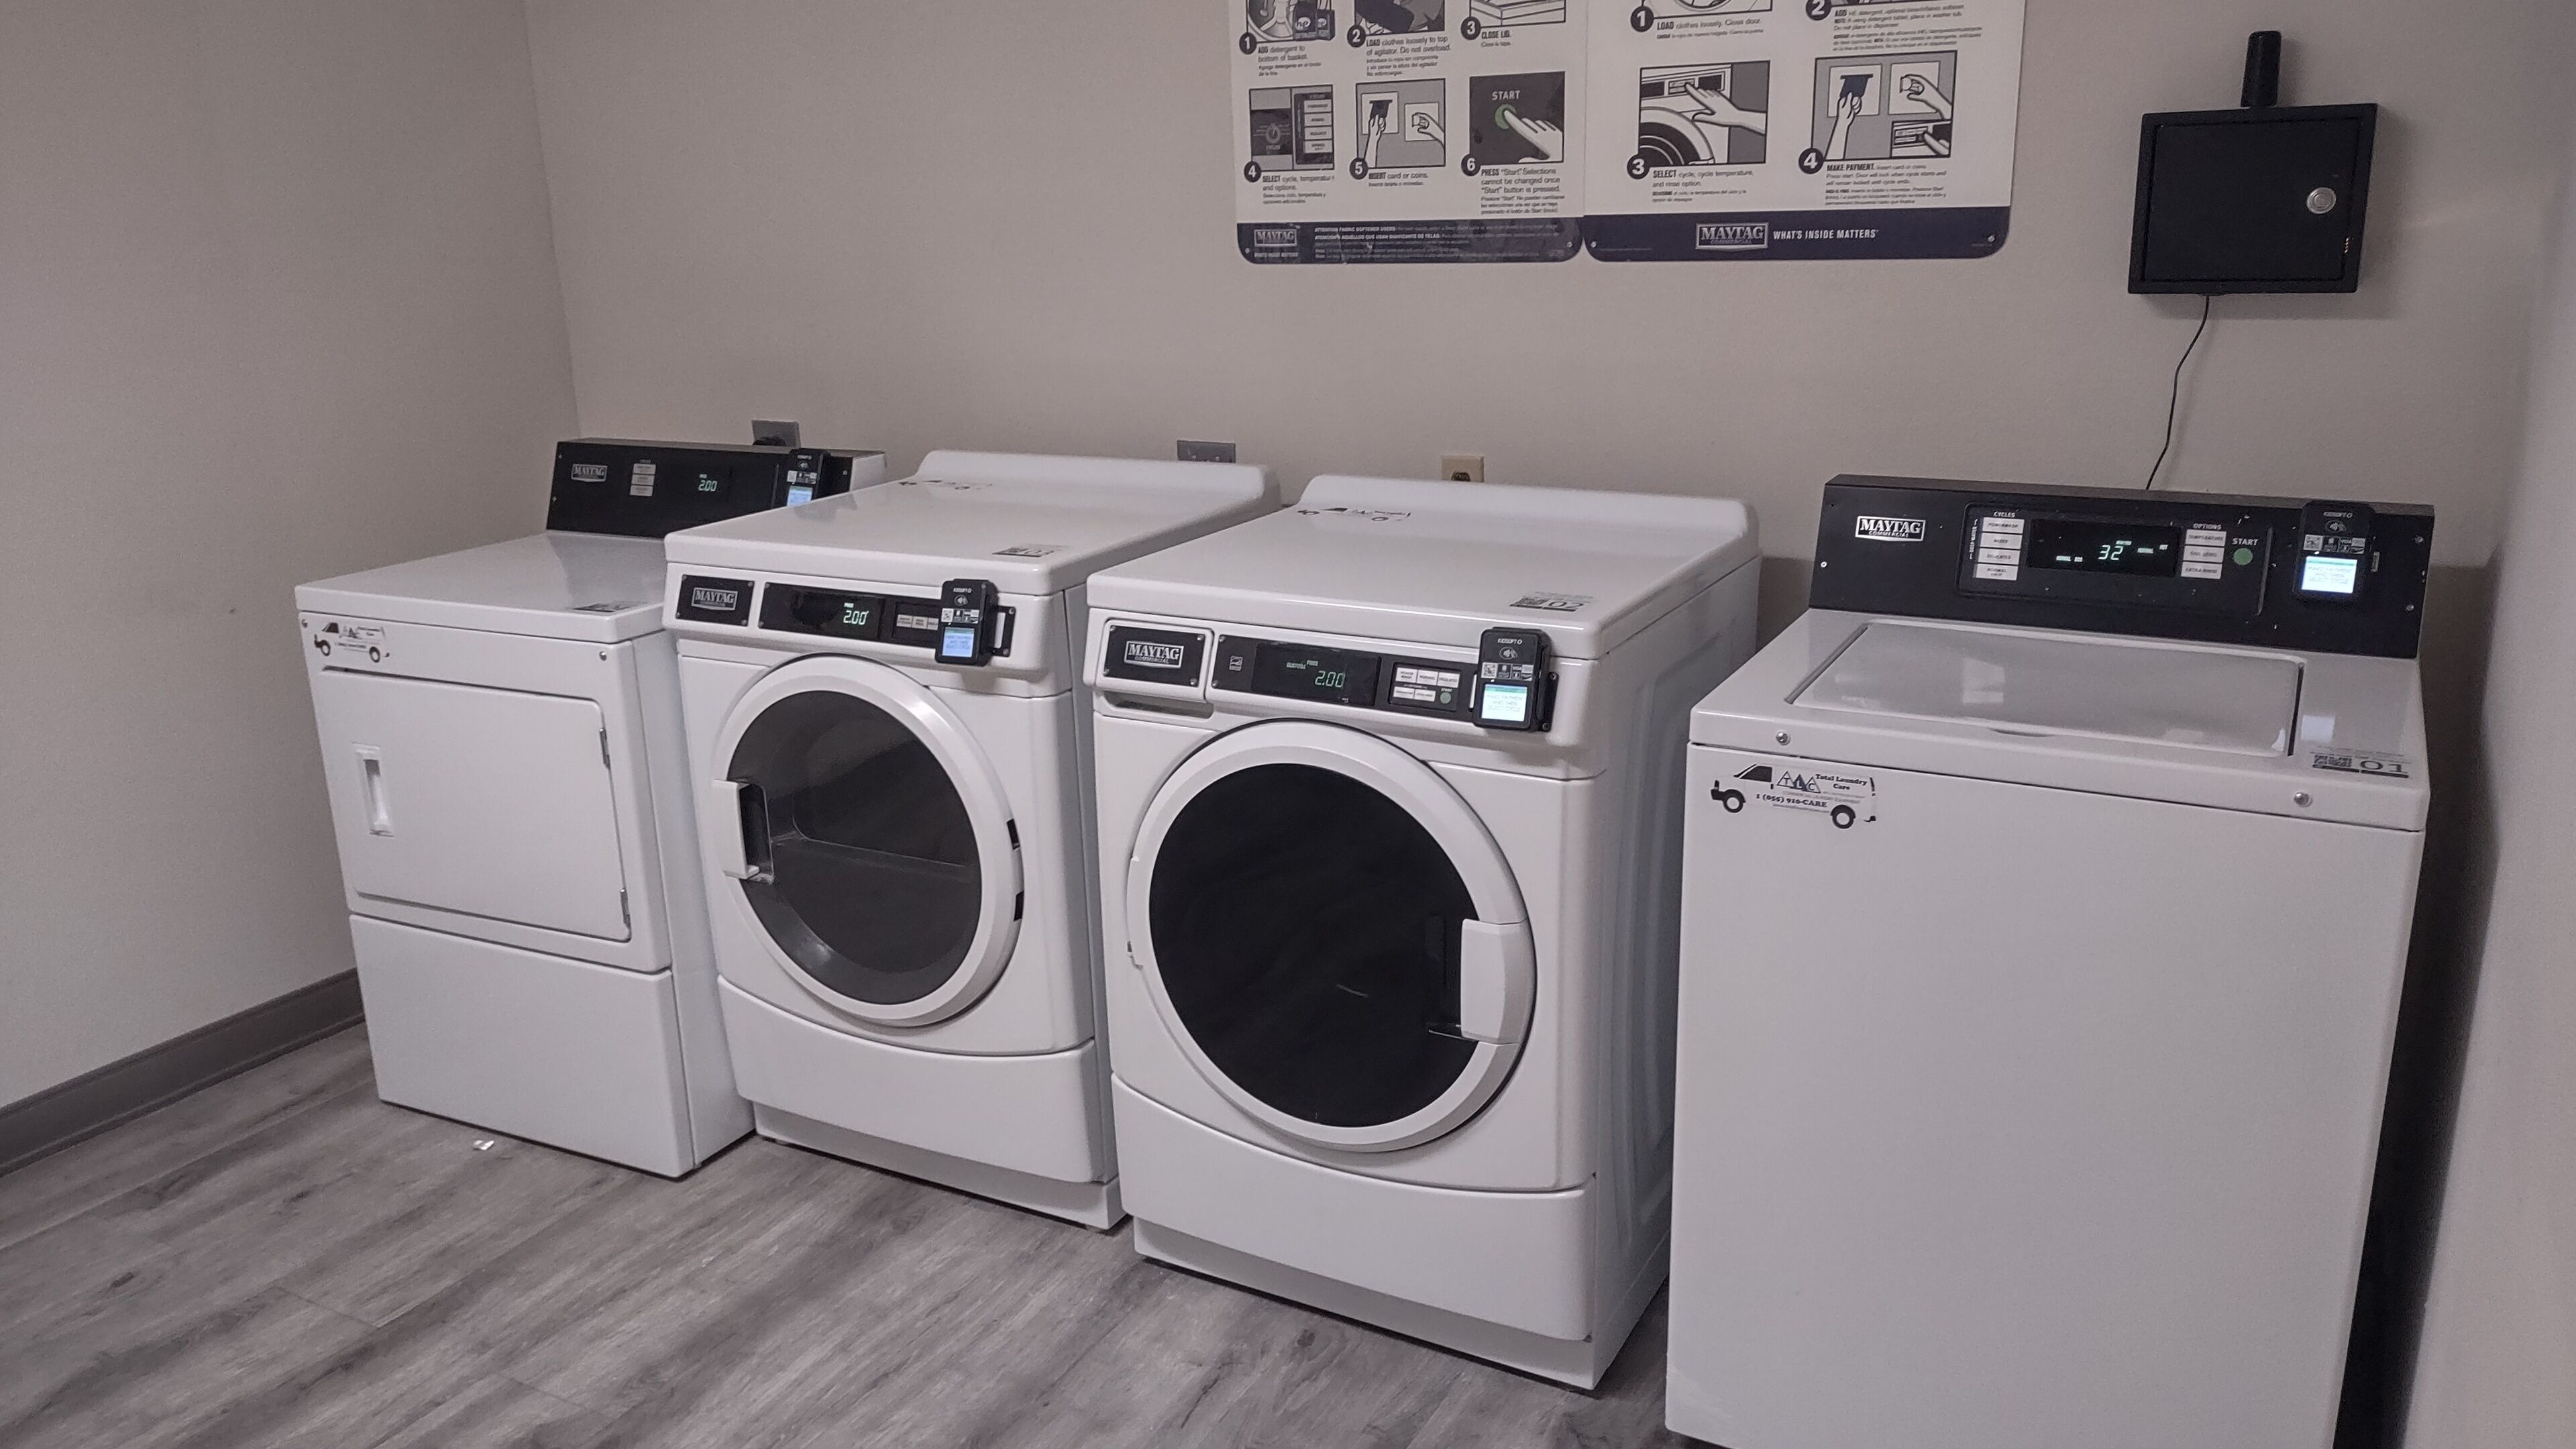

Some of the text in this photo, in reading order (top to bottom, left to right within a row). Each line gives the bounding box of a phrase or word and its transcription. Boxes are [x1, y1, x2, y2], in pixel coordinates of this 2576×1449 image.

[1811, 0, 1825, 15] 2
[1637, 10, 1646, 27] 1
[1466, 20, 1476, 35] 3
[1657, 21, 1674, 30] LOAD
[1352, 28, 1361, 43] 2
[1481, 30, 1499, 39] CLOSE
[1244, 36, 1250, 50] 1
[1491, 90, 1521, 101] START
[1466, 157, 1476, 172] 6
[1632, 158, 1645, 175] 3
[1803, 152, 1818, 169] 4
[1248, 165, 1257, 178] 4
[1354, 162, 1363, 174] 5
[1653, 170, 1677, 178] SELECT
[1827, 164, 1844, 172] MAKE
[1514, 176, 1542, 186] changed
[1256, 231, 1295, 241] MAYTAG
[1701, 225, 1764, 240] MAYTAG
[1773, 230, 1802, 239] WHAT'S
[1805, 229, 1834, 239] INSIDE
[573, 466, 605, 476] MAYTAG
[1860, 519, 1922, 534] MAYTAG
[2192, 523, 2222, 531] OPTIONS
[1868, 530, 1909, 538] COMMERCIAL
[2232, 537, 2259, 546] START
[2098, 544, 2125, 561] 32
[696, 590, 735, 604] MAYTAG
[1128, 643, 1181, 661] MAYTAG
[1315, 670, 1346, 688] 2.00
[2360, 760, 2408, 773] 01
[1836, 776, 1868, 786] Laundry
